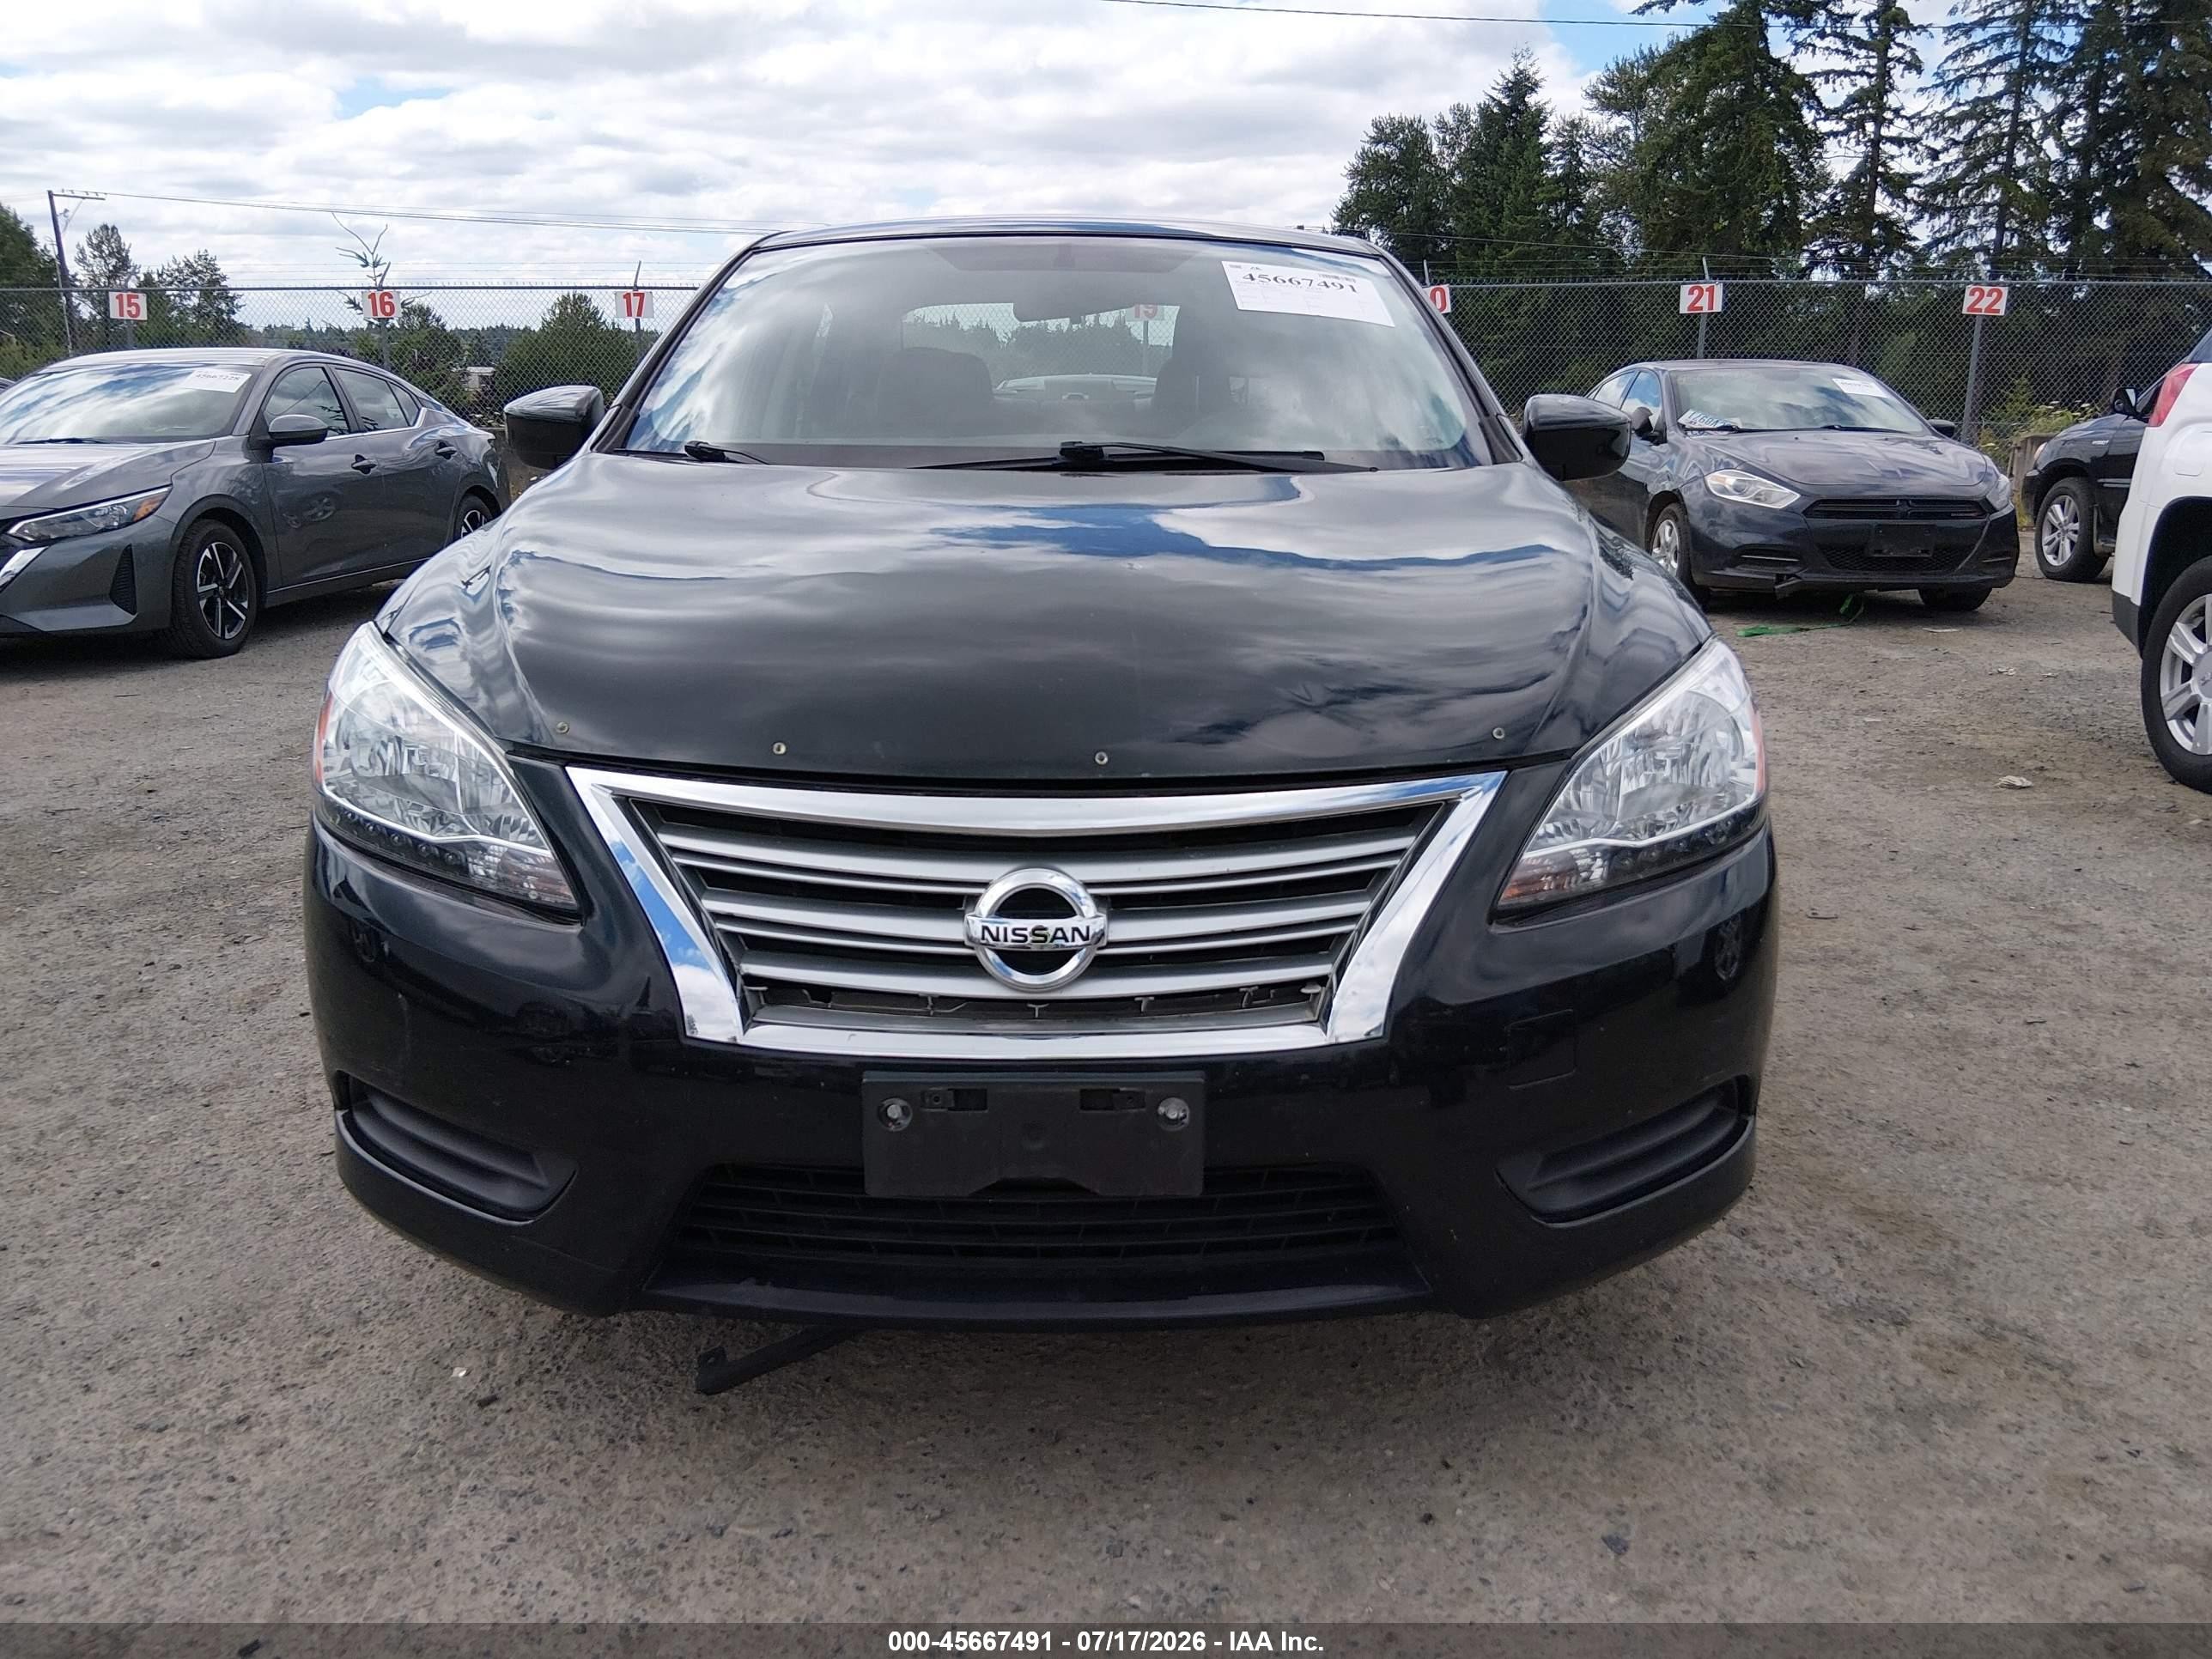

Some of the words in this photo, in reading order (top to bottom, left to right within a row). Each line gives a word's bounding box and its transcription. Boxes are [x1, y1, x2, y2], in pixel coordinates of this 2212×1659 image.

[1243, 272, 1359, 294] 45667491
[115, 294, 140, 318] 15
[368, 291, 395, 317] 16
[623, 292, 646, 317] 17
[1429, 286, 1447, 313] 0
[1687, 285, 1716, 313] 21
[1966, 288, 2003, 314] 22
[981, 925, 1091, 944] NISSAN
